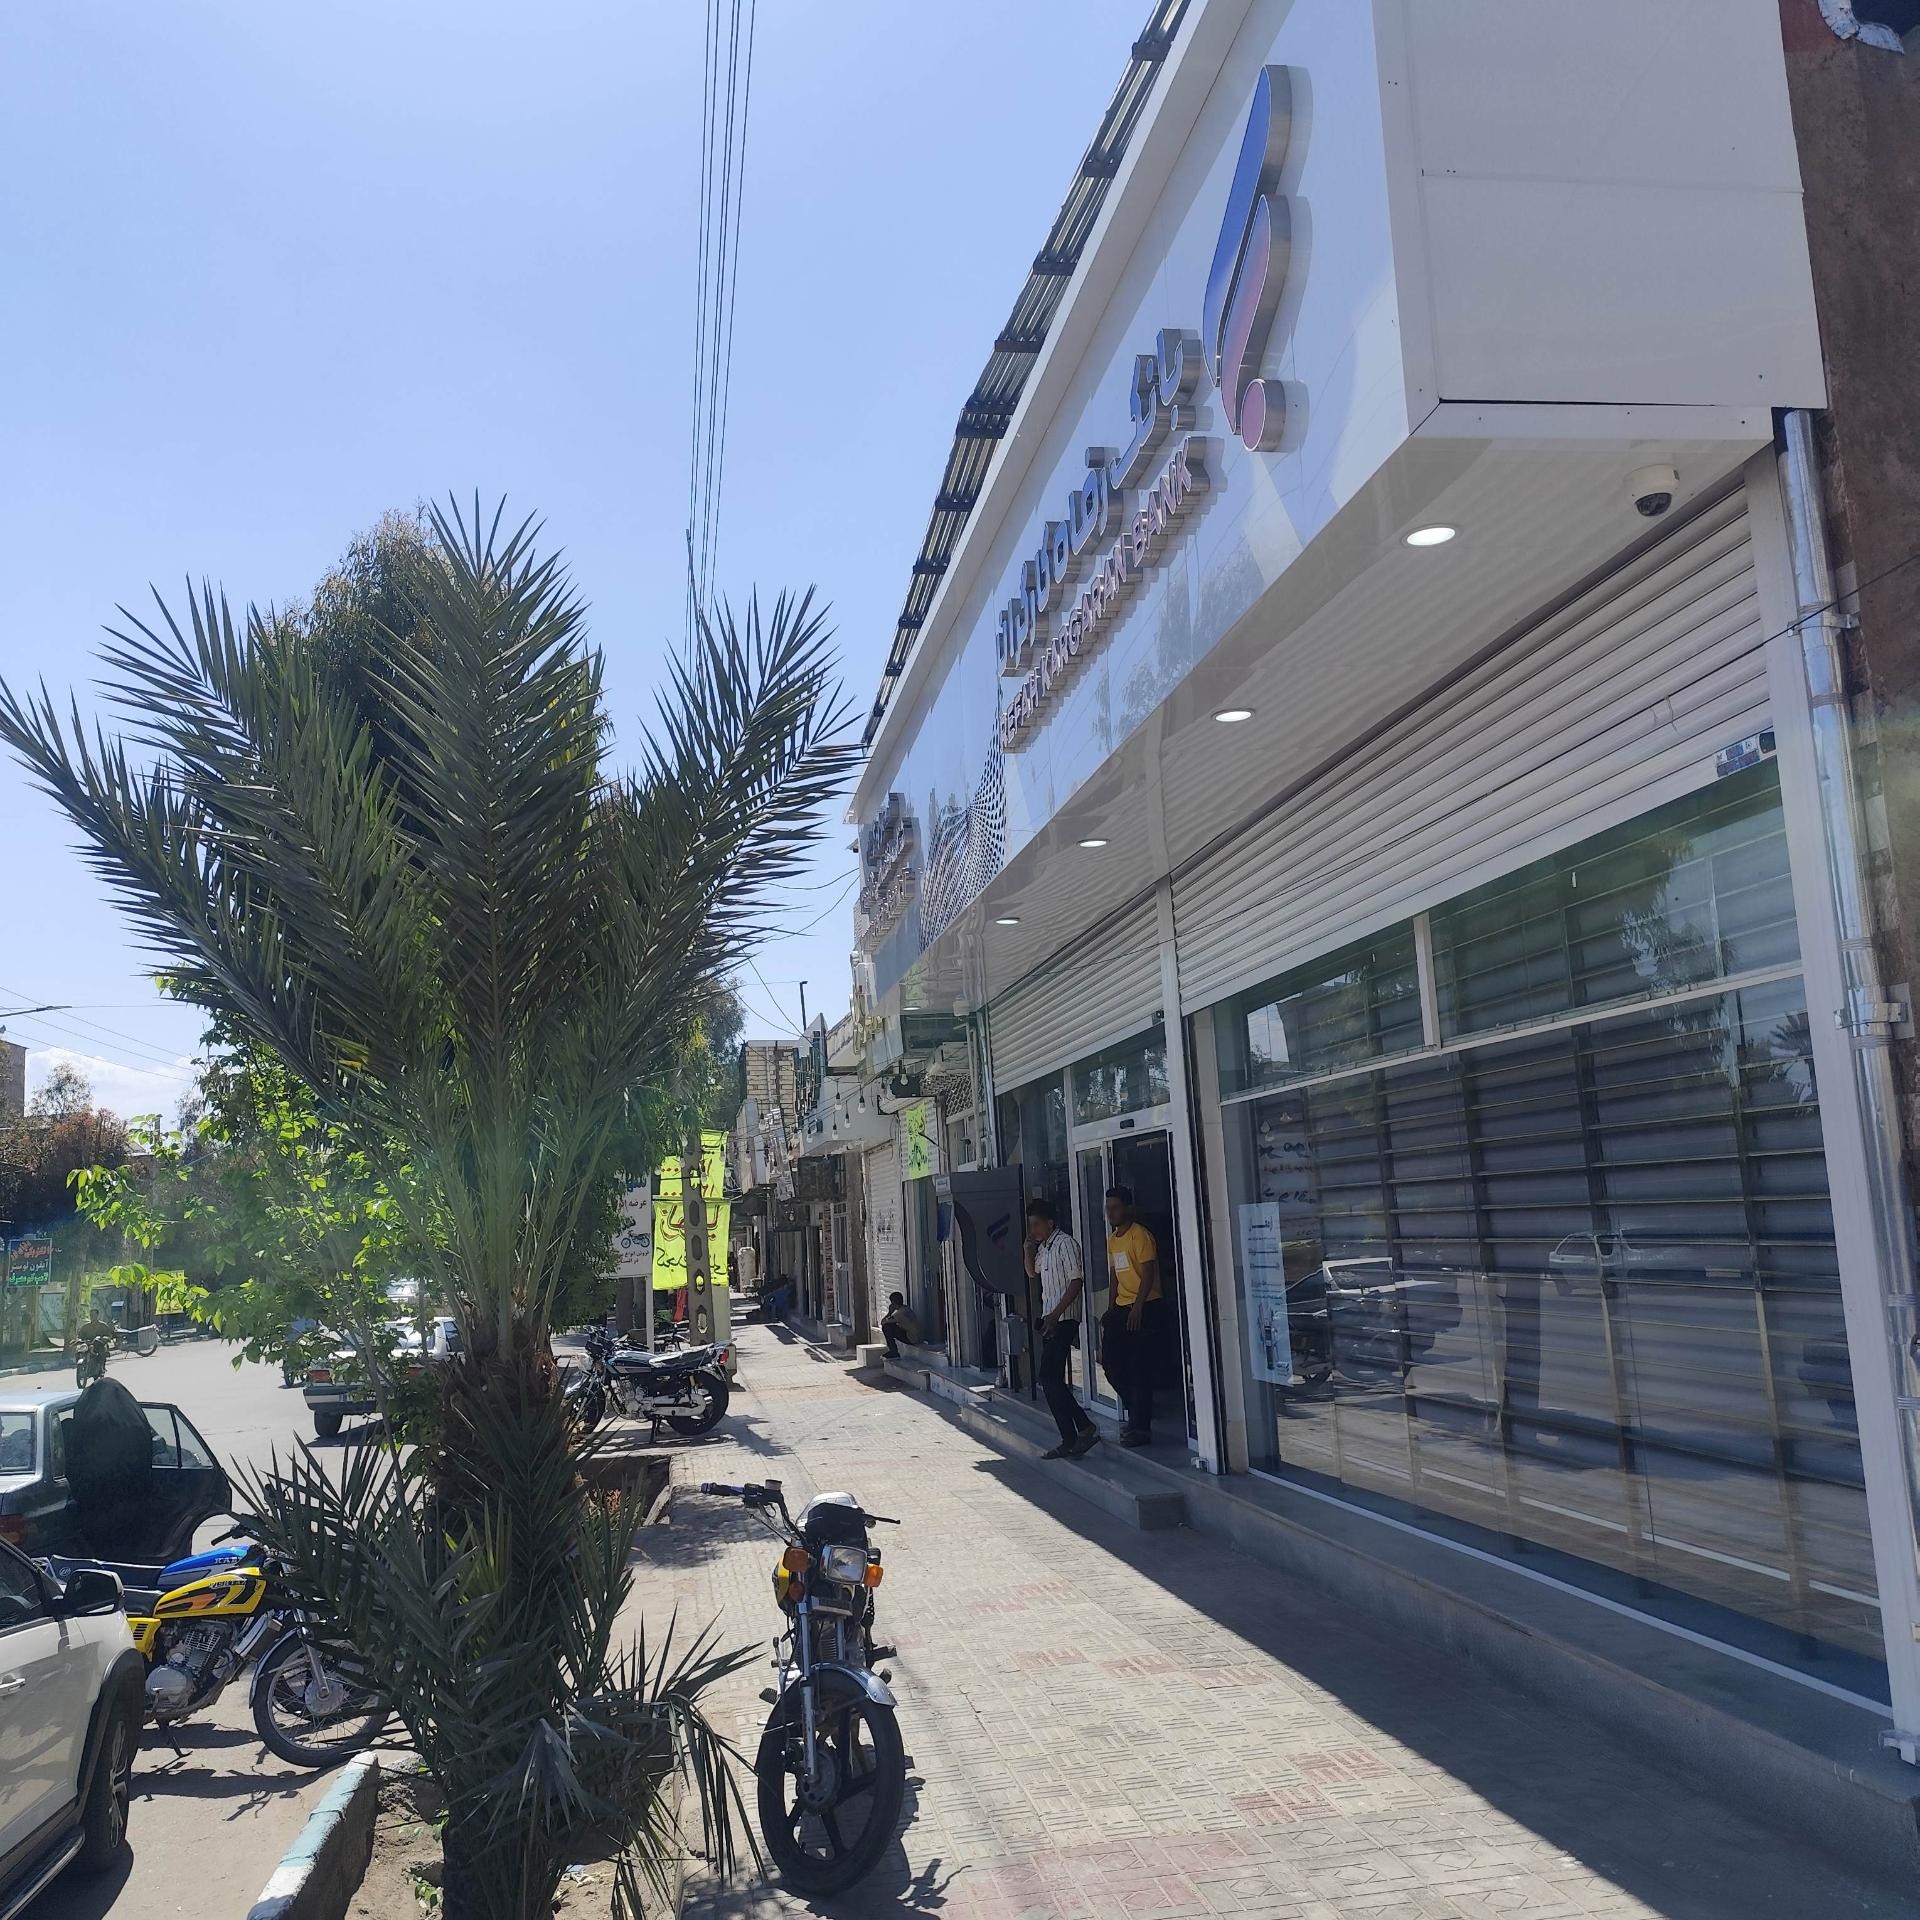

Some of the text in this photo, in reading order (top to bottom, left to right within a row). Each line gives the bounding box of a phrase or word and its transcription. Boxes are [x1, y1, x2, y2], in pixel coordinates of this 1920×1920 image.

[997, 327, 1198, 676] بانک رفاه کارگران
[1000, 436, 1197, 751] REFAH KARGARAN BANK
